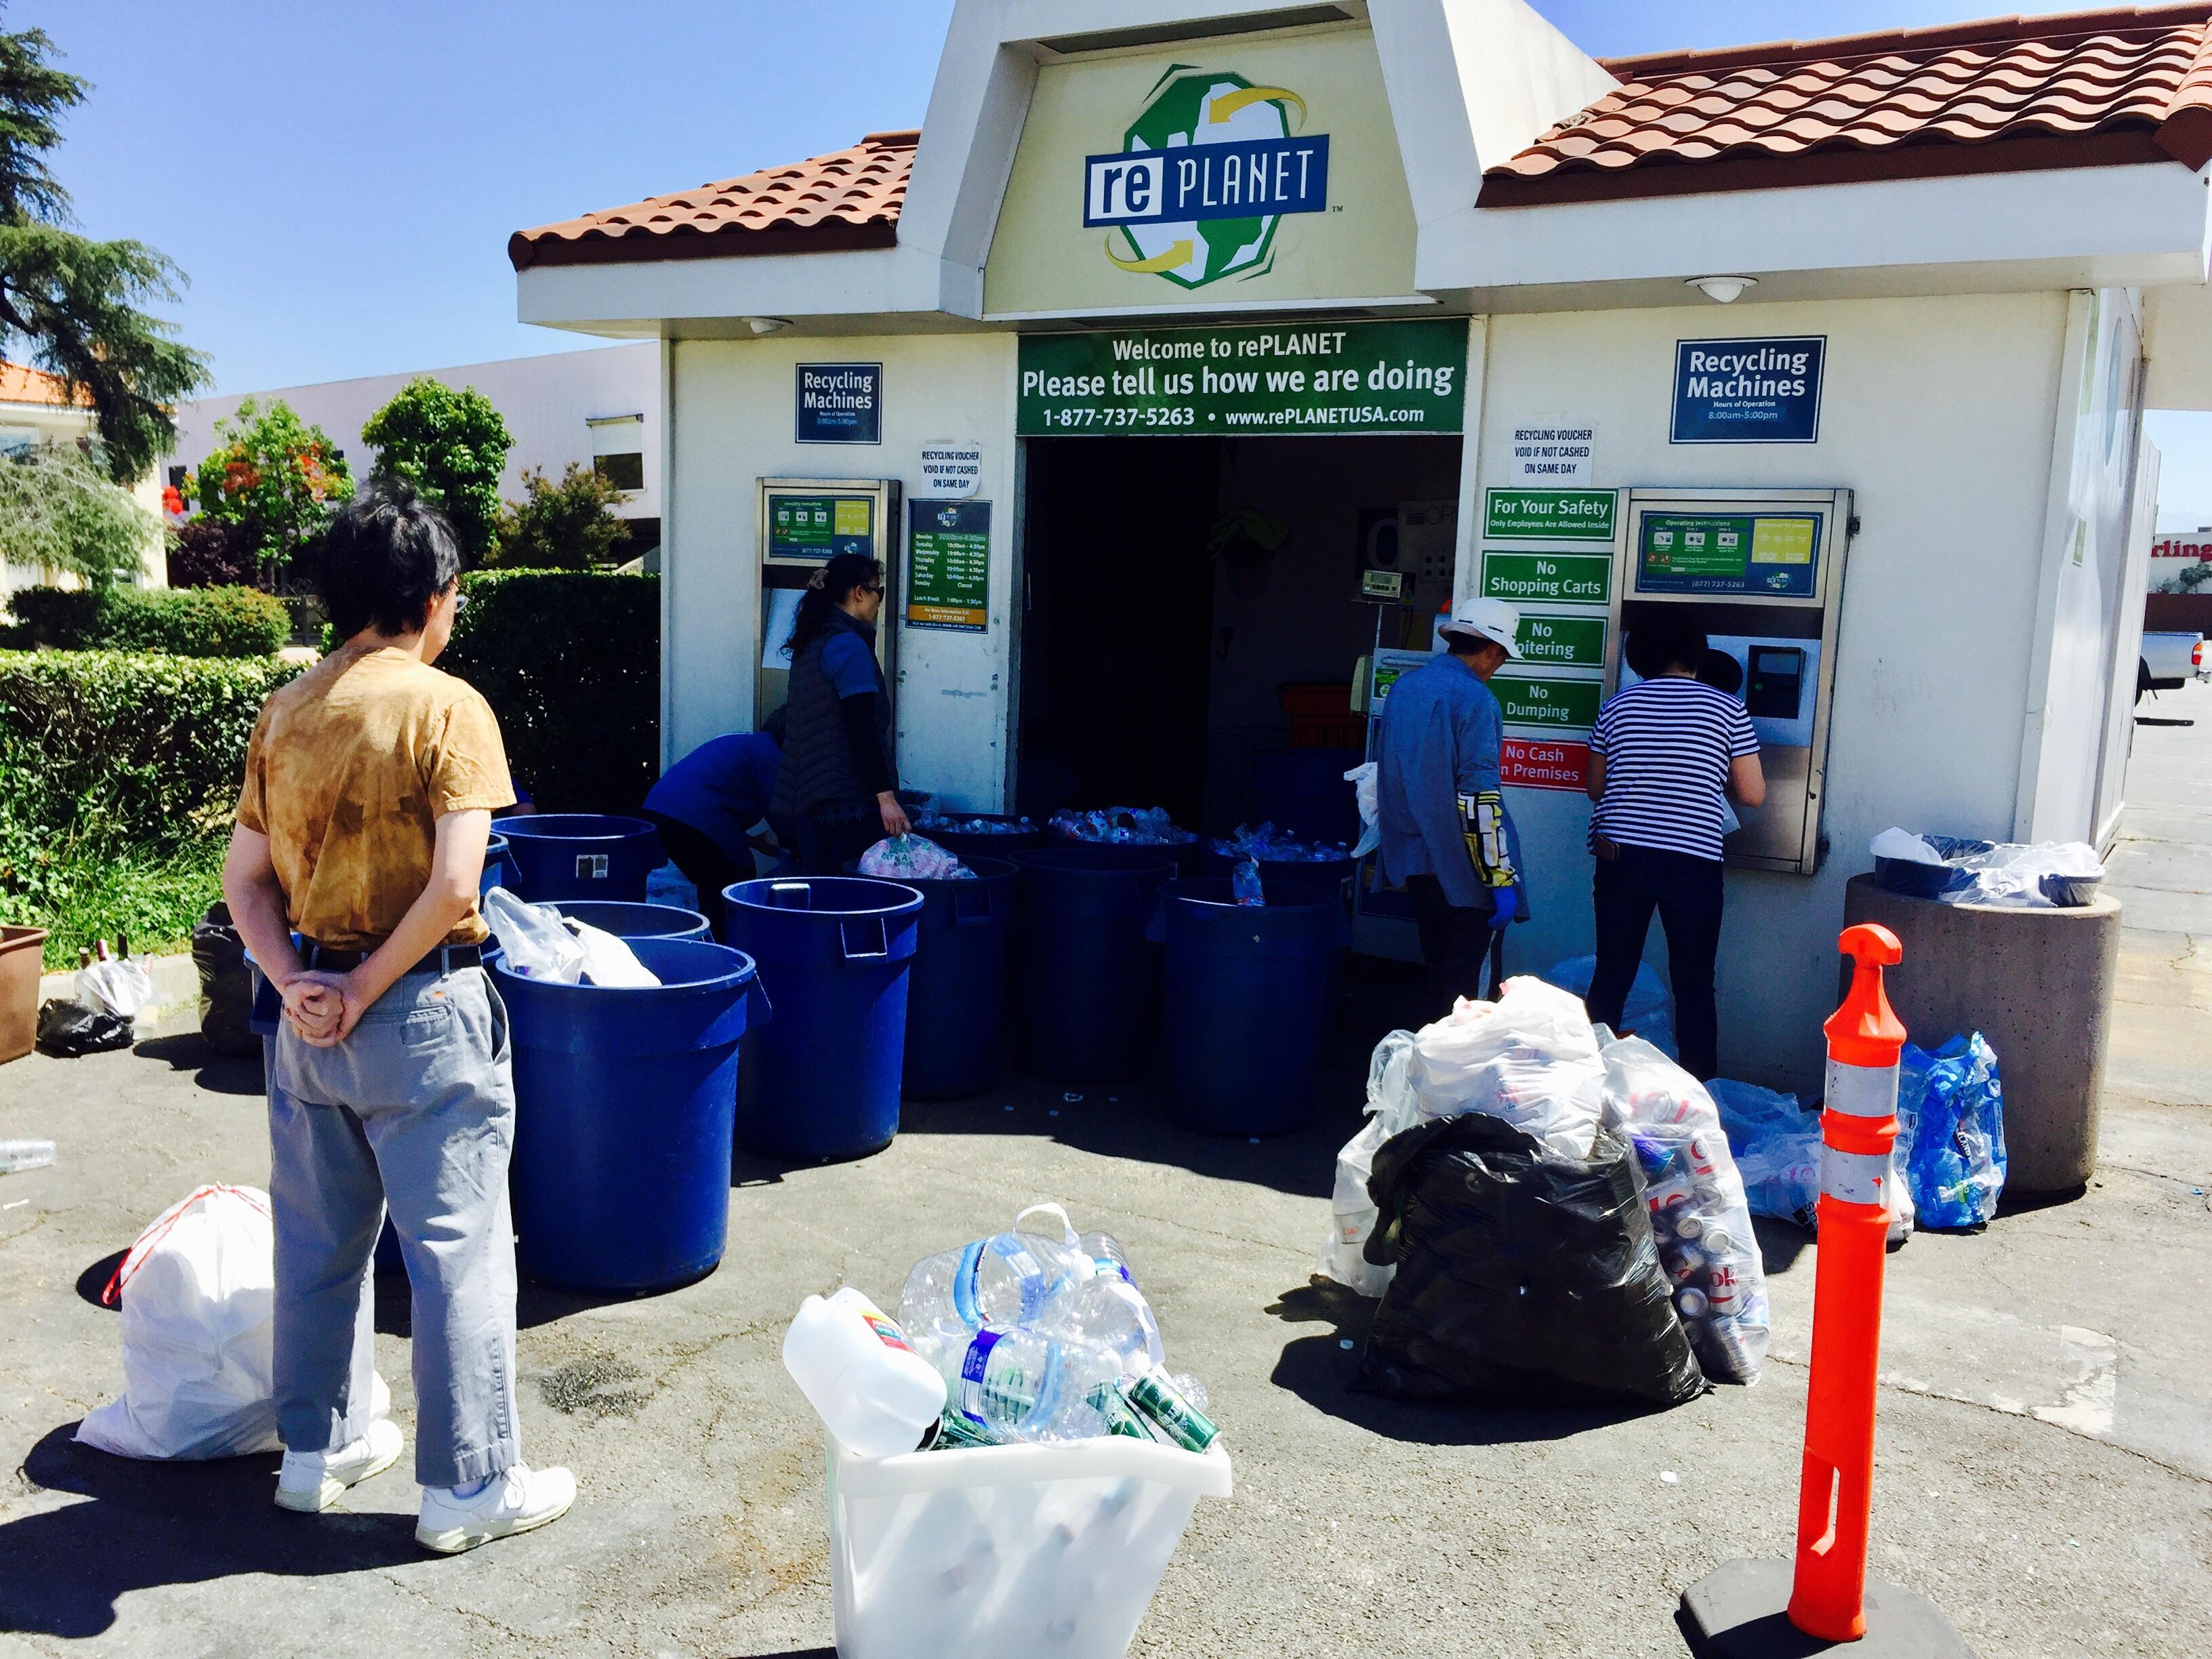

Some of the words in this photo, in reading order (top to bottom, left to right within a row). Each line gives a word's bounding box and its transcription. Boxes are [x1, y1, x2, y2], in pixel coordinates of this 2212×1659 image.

[1103, 163, 1151, 213] re
[1177, 150, 1313, 209] PLANET
[1113, 340, 1206, 361] Welcome
[1210, 339, 1231, 357] to
[1238, 332, 1346, 357] rePLANET
[1689, 348, 1809, 377] Recycling
[804, 371, 873, 393] Recycling
[1023, 371, 1105, 397] Please
[1113, 367, 1155, 395] tell
[1164, 373, 1194, 395] us
[1202, 365, 1258, 394] how
[1267, 372, 1305, 392] we
[1314, 368, 1359, 391] are
[1368, 359, 1454, 396] doing
[1687, 374, 1805, 398] Machines
[804, 391, 872, 409] Machines
[1742, 401, 1776, 409] Operation
[1043, 407, 1195, 426] 1-877-737-5263
[1225, 405, 1425, 426] www.rePLANETUSA.com
[1708, 411, 1778, 420] 8:00am-5:00pm
[1515, 430, 1555, 441] RECYCLING
[1557, 430, 1593, 441] VOUCHER
[922, 451, 954, 461] RECYCLING
[955, 451, 979, 461] VOUCHER
[1515, 447, 1532, 457] VOID
[1534, 447, 1540, 457] IF
[1541, 447, 1558, 457] NOT
[1559, 447, 1590, 457] CASHED
[923, 465, 939, 474] VOID
[939, 465, 945, 474] IF
[945, 466, 956, 474] NOT
[957, 466, 978, 475] CASHED
[1525, 464, 1535, 473] ON
[1537, 464, 1559, 474] SAME
[1561, 464, 1577, 474] DAY
[933, 479, 942, 488] ON
[943, 479, 958, 489] SAME
[958, 479, 970, 489] DAY
[1494, 499, 1517, 514] For
[1520, 499, 1555, 514] Your
[1558, 499, 1609, 518] Safety
[1490, 520, 1506, 528] Only
[1507, 520, 1544, 529] Employees
[1558, 520, 1586, 529] Allowed
[2151, 540, 2212, 562] rling
[1536, 560, 1556, 575] No
[1490, 577, 1559, 596] Shopping
[1563, 579, 1601, 594] Carts
[1532, 622, 1552, 637] No
[1517, 641, 1575, 659] oitering
[1529, 685, 1549, 699] No
[1507, 702, 1570, 721] Dumping
[1506, 745, 1525, 760] No
[1529, 747, 1564, 762] Cash
[1500, 765, 1509, 776] n
[1513, 764, 1579, 781] Premises
